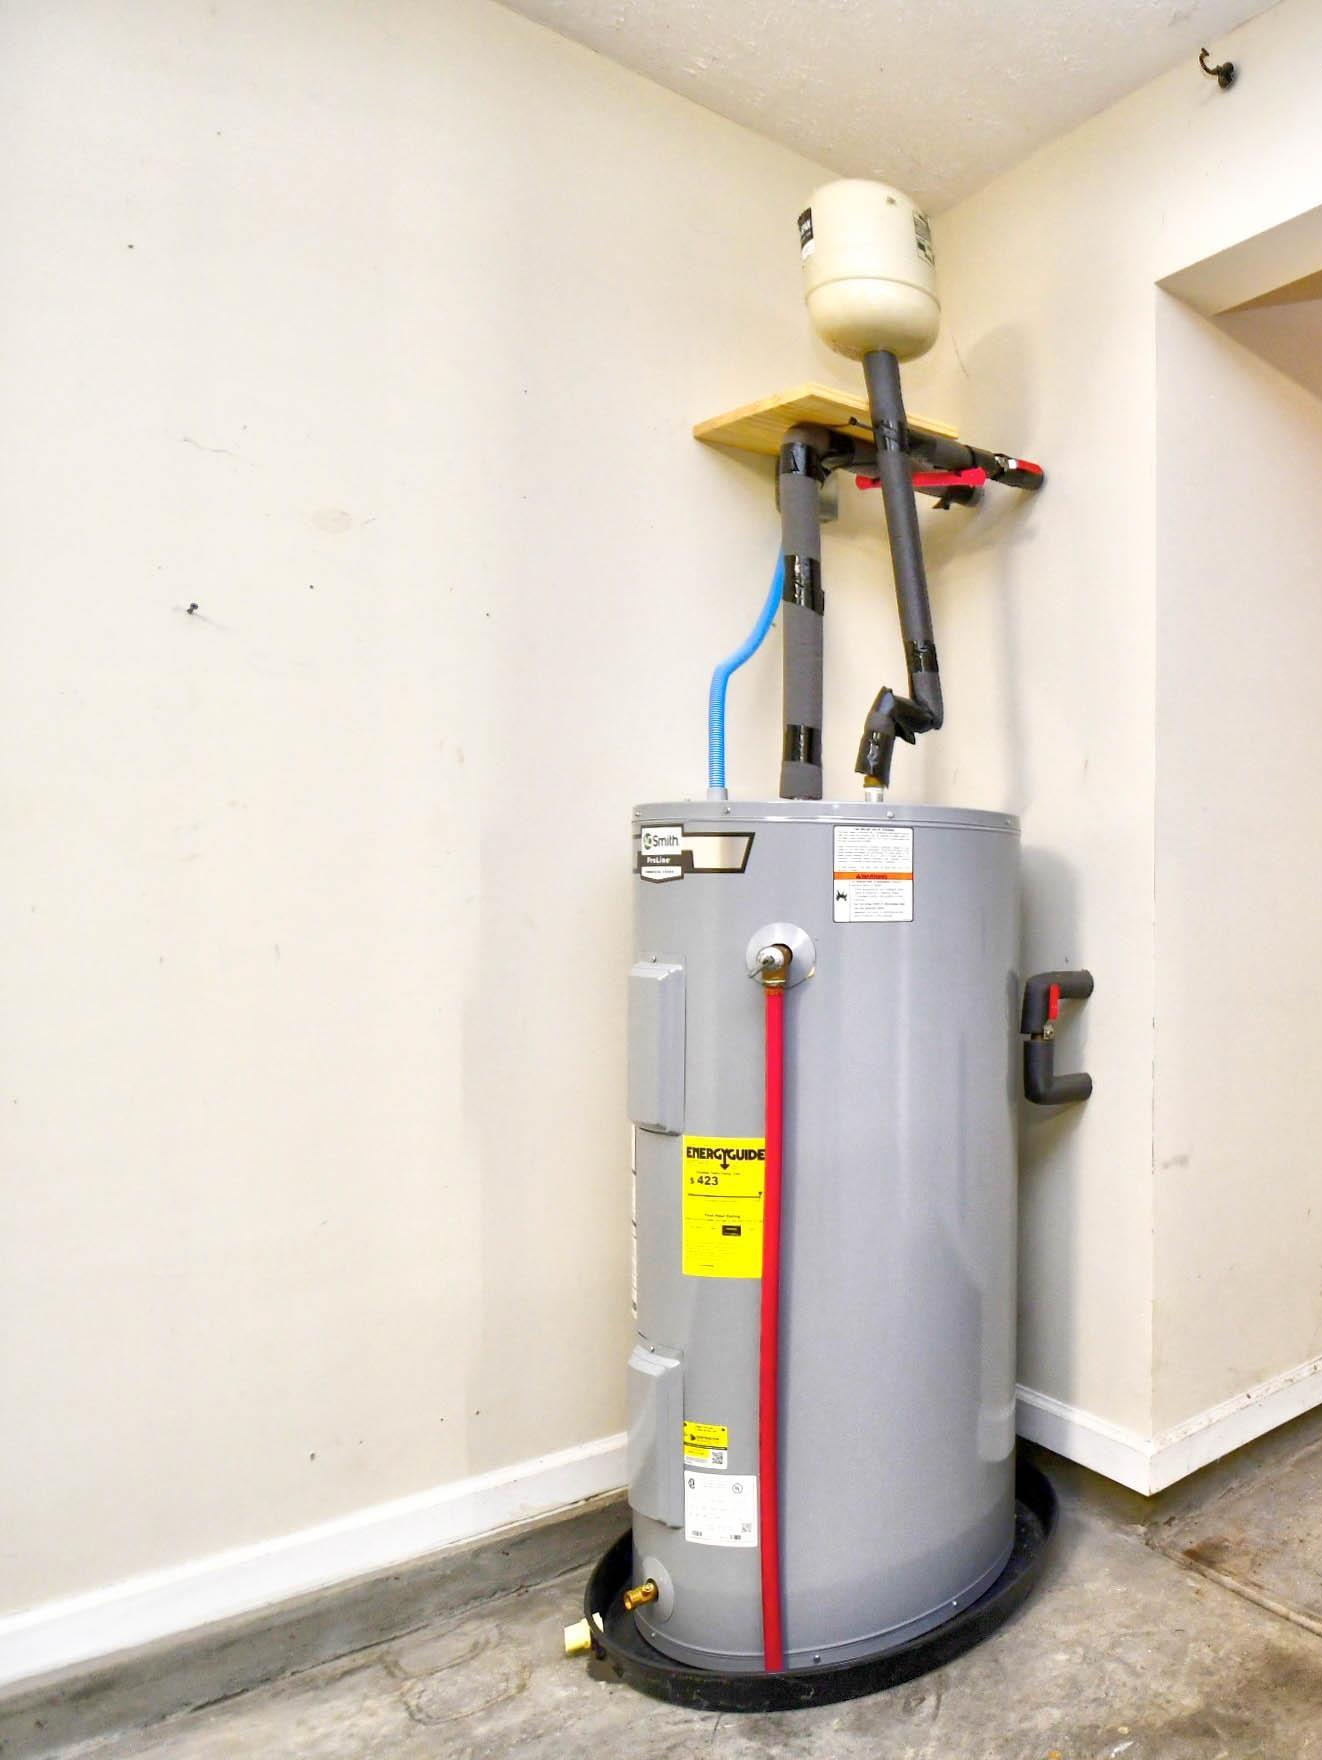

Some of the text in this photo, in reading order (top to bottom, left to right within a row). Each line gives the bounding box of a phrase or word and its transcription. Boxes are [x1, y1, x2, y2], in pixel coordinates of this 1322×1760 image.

[653, 835, 679, 847] Smith
[686, 1146, 766, 1161] ENERGYGUIDE
[697, 1176, 718, 1185] 423
